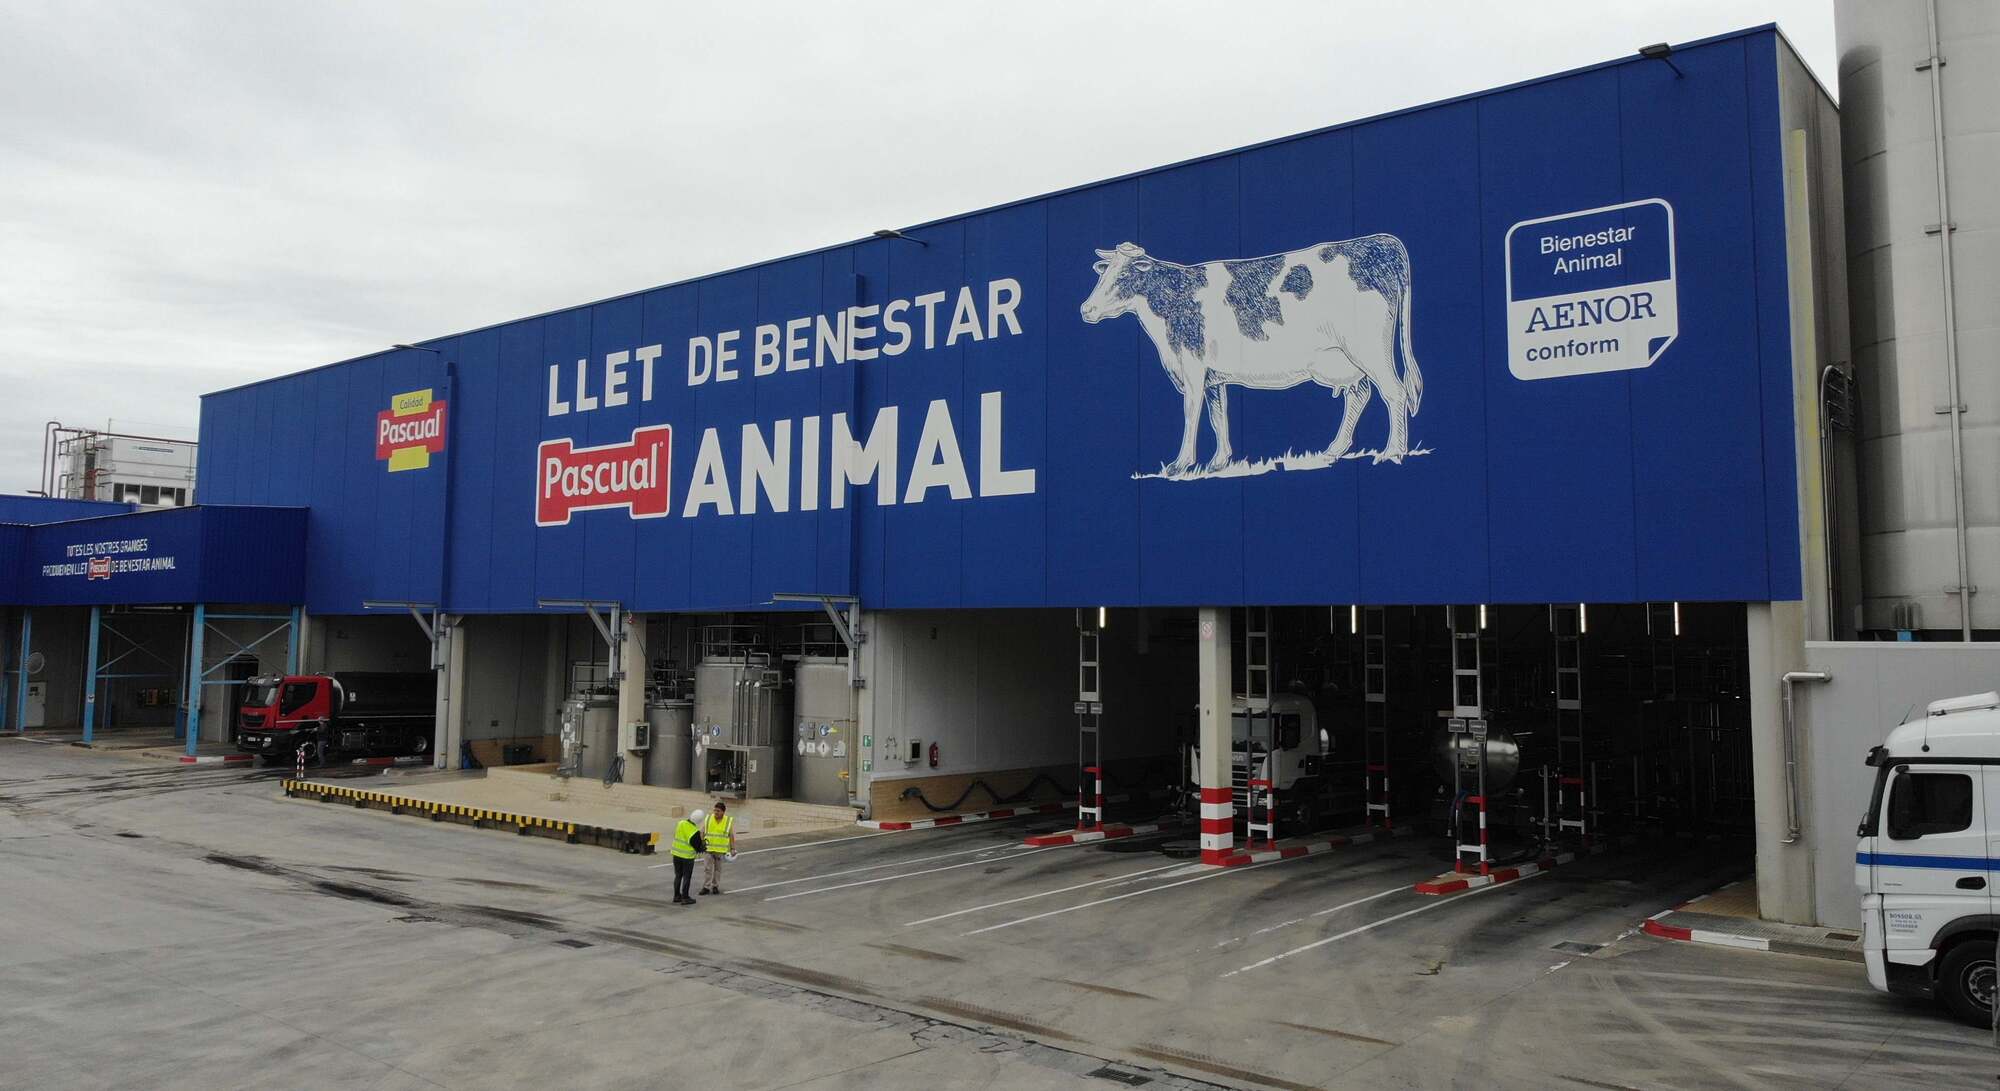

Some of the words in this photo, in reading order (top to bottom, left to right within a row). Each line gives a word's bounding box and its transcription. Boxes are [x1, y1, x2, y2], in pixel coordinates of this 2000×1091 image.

[1541, 226, 1635, 255] Bienestar
[1553, 248, 1622, 275] Animal
[1525, 292, 1657, 334] AENOR
[548, 343, 662, 416] LLET
[688, 330, 740, 387] DE
[754, 278, 1022, 376] BENESTAR
[1526, 338, 1619, 361] conform
[399, 396, 424, 409] Calidad
[380, 409, 440, 445] Pascual
[682, 391, 1036, 518] ANIMAL
[545, 443, 657, 499] Pascual
[66, 544, 82, 557] TOTES
[83, 543, 94, 556] LES
[120, 538, 148, 553] GRANGES
[75, 562, 88, 575] LLET
[111, 560, 119, 573] DE
[119, 558, 150, 573] BENESTAR
[151, 556, 175, 571] ANIMAL
